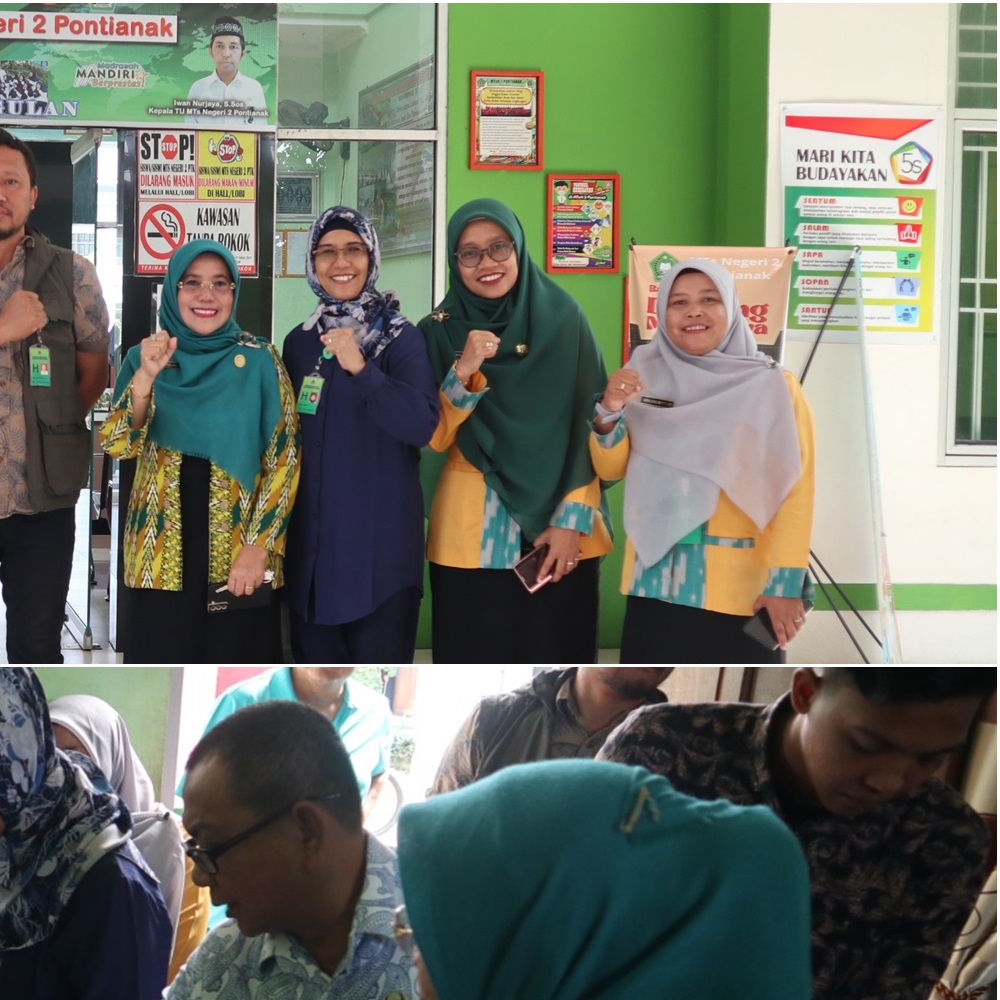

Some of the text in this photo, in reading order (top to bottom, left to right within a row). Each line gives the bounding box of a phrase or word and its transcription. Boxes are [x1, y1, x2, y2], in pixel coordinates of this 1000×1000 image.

[32, 14, 47, 33] 2
[54, 15, 174, 37] Pontianak
[97, 62, 139, 70] Madrasah
[76, 69, 135, 79] MANDIRI
[192, 100, 222, 108] Nurjaya,
[148, 107, 173, 115] Kepala
[234, 109, 269, 117] Pontianak
[162, 142, 178, 152] STOP
[219, 144, 236, 156] STOP
[796, 149, 876, 164] MARI KITA
[796, 166, 888, 182] BUDAYAKAN
[140, 174, 195, 187] DILARANG MASUK
[207, 189, 214, 197] DI
[803, 197, 836, 205] SENYUM
[197, 207, 241, 226] KAWASAN
[721, 257, 768, 268] Negeri
[771, 258, 781, 266] 2
[32, 363, 39, 373] H
[300, 391, 309, 400] H
